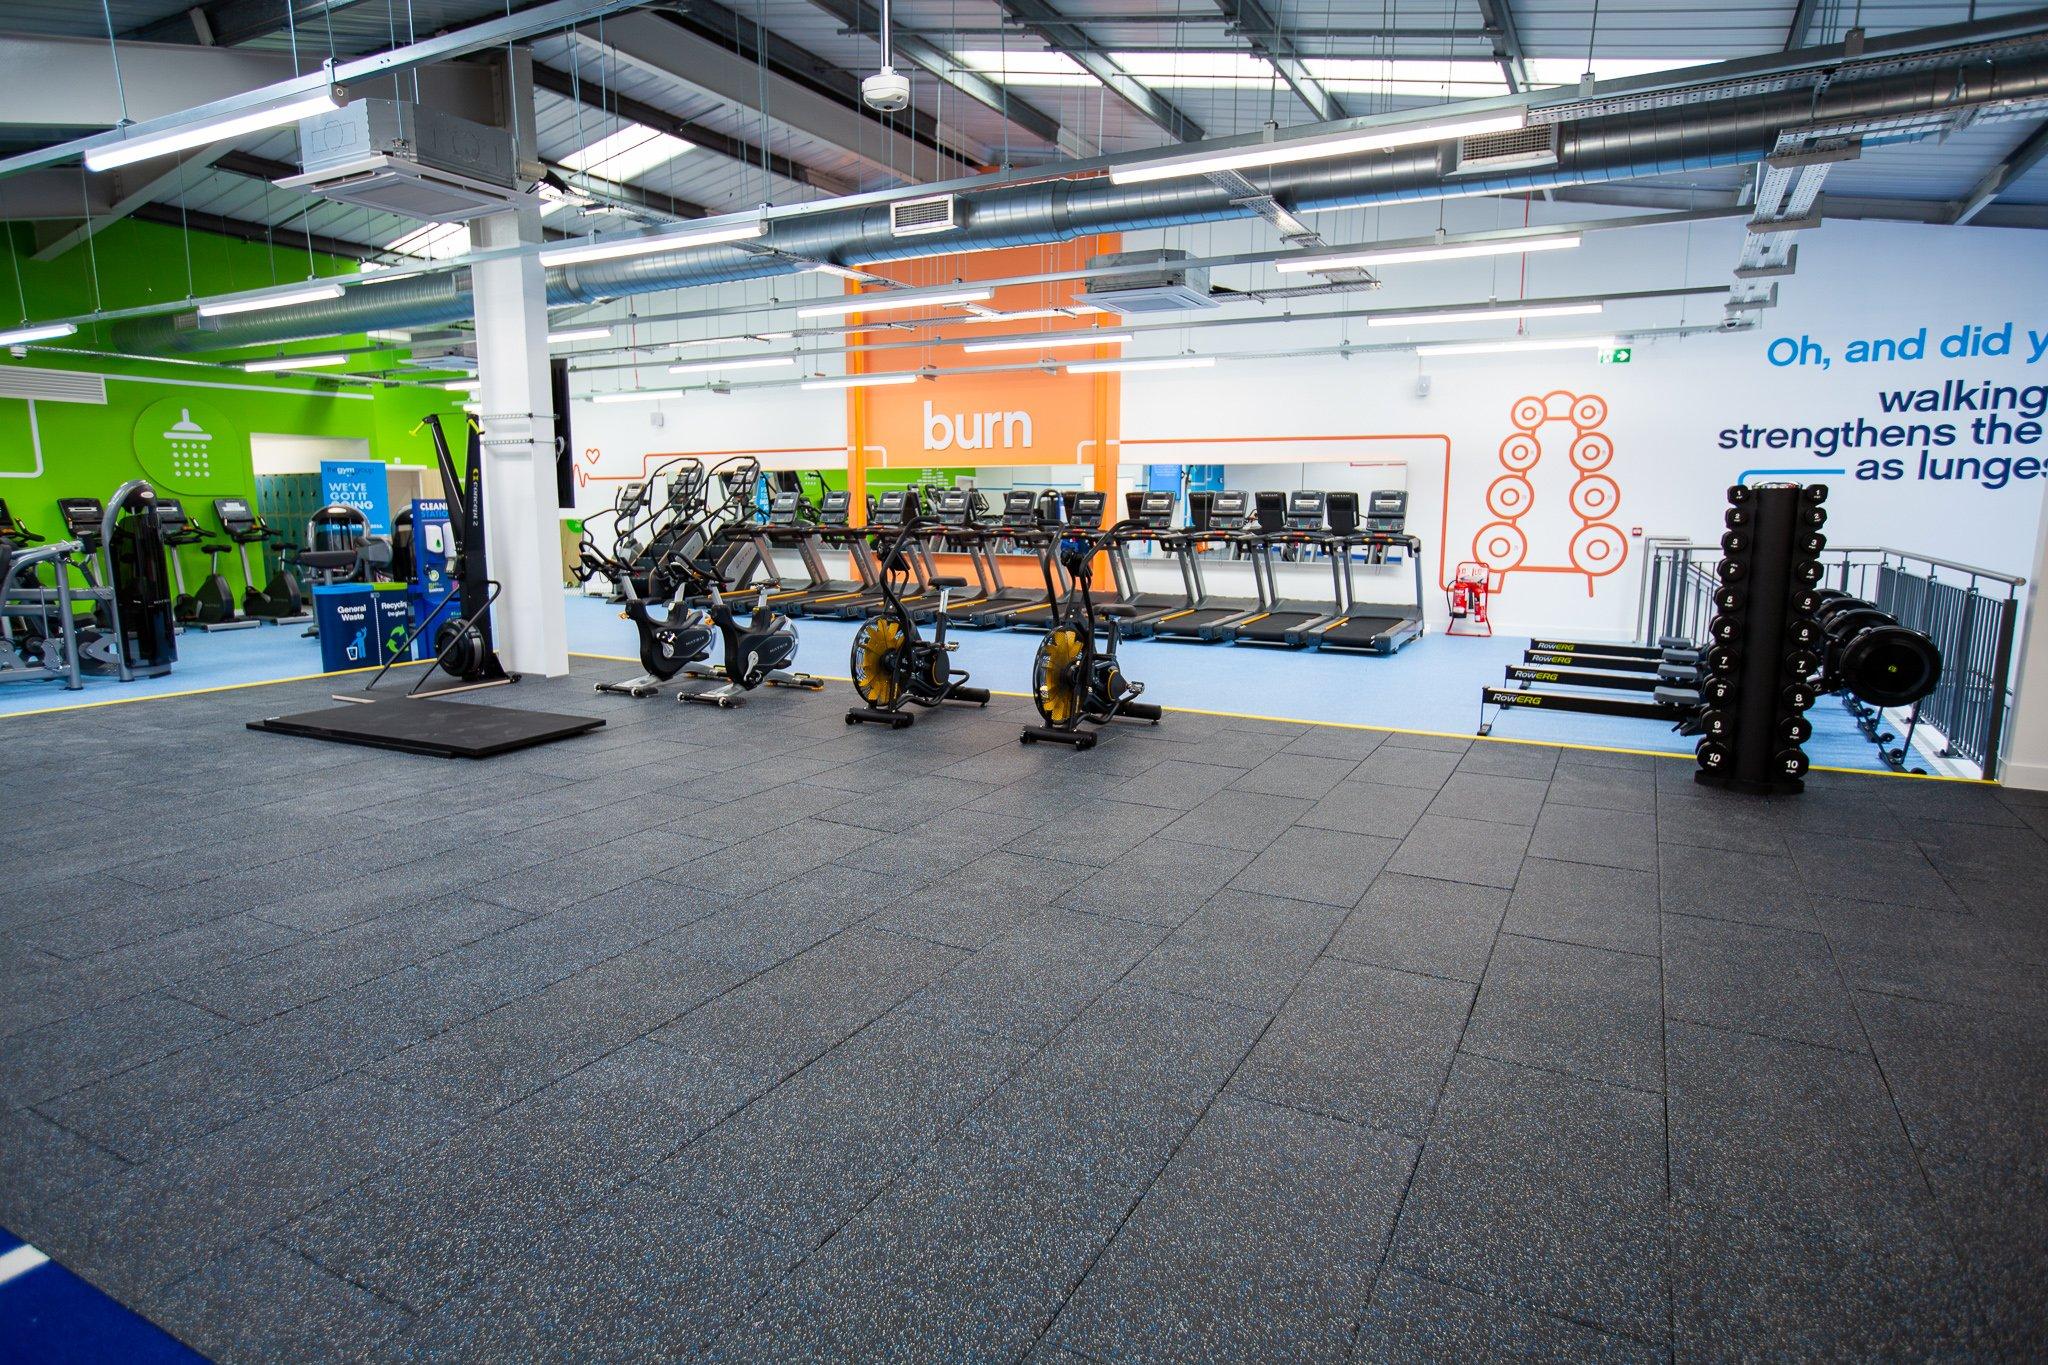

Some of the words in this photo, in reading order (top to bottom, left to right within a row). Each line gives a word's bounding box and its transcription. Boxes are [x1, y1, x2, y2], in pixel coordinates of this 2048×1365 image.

[1767, 335, 1831, 370] Oh,
[1845, 328, 1927, 362] and
[1940, 322, 2012, 357] did
[1878, 380, 2048, 419] walking
[923, 400, 1033, 450] burn
[1718, 418, 1957, 458] strengthens
[1971, 413, 2042, 445] the
[1855, 458, 1904, 481] as
[329, 492, 355, 500] GOT
[358, 492, 367, 500] IT
[419, 502, 449, 511] CLEANI
[421, 511, 449, 519] STATIO
[381, 601, 408, 610] Recyclin
[1804, 597, 1811, 605] 5
[337, 604, 367, 614] General
[341, 613, 365, 621] Waste
[1721, 656, 1728, 664] 7
[1514, 670, 1559, 681] RowERG
[1493, 693, 1542, 705] RowERG
[1795, 693, 1803, 702] 8
[1714, 721, 1721, 729] 9
[1792, 727, 1799, 735] 9
[1709, 753, 1721, 763] 10
[1786, 760, 1798, 769] 10
